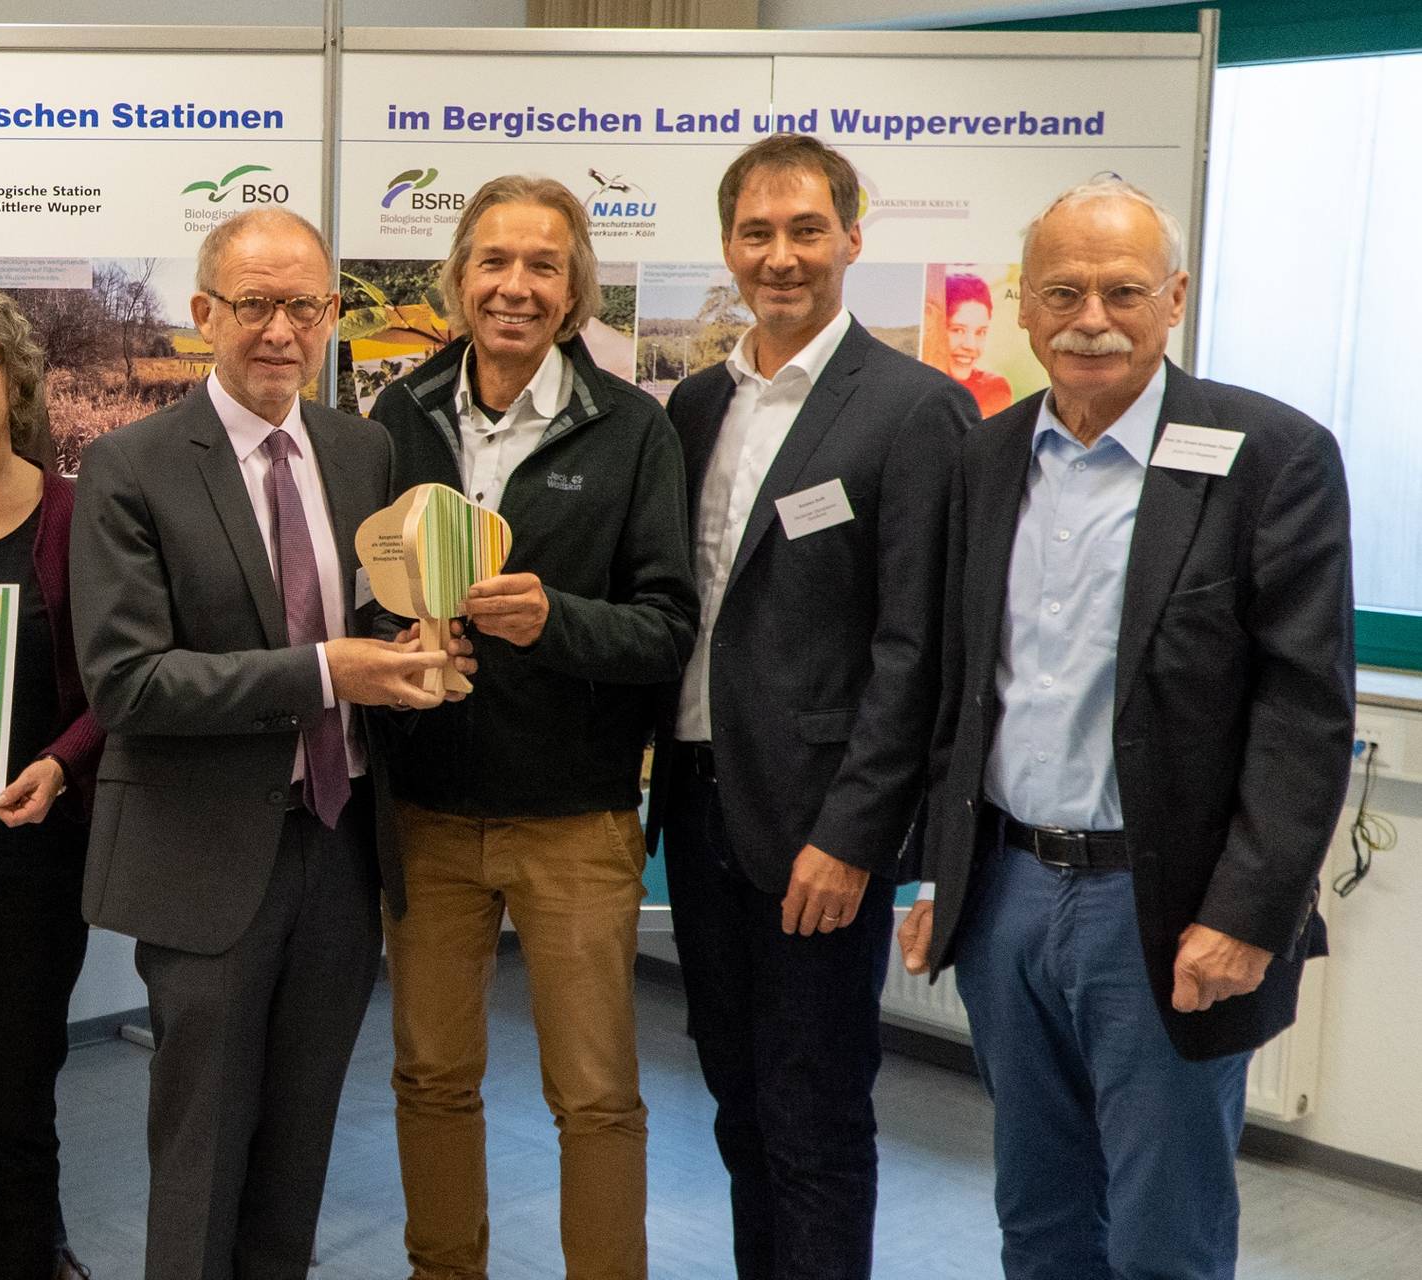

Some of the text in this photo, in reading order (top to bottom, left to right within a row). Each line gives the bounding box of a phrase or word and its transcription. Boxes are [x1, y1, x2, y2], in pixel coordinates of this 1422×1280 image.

[112, 103, 284, 129] Stationen
[387, 104, 1105, 140] im Bergischen Land und Wupperverband
[53, 185, 101, 196] Station
[242, 184, 289, 203] BSO
[412, 193, 465, 210] BSRB
[47, 202, 102, 215] Wupper
[593, 202, 657, 217] NABU
[380, 214, 460, 225] Biologische Statio
[184, 222, 218, 232] Oberb
[380, 226, 433, 237] Rhein-Berg
[635, 229, 656, 237] Köln
[1004, 288, 1021, 300] Au
